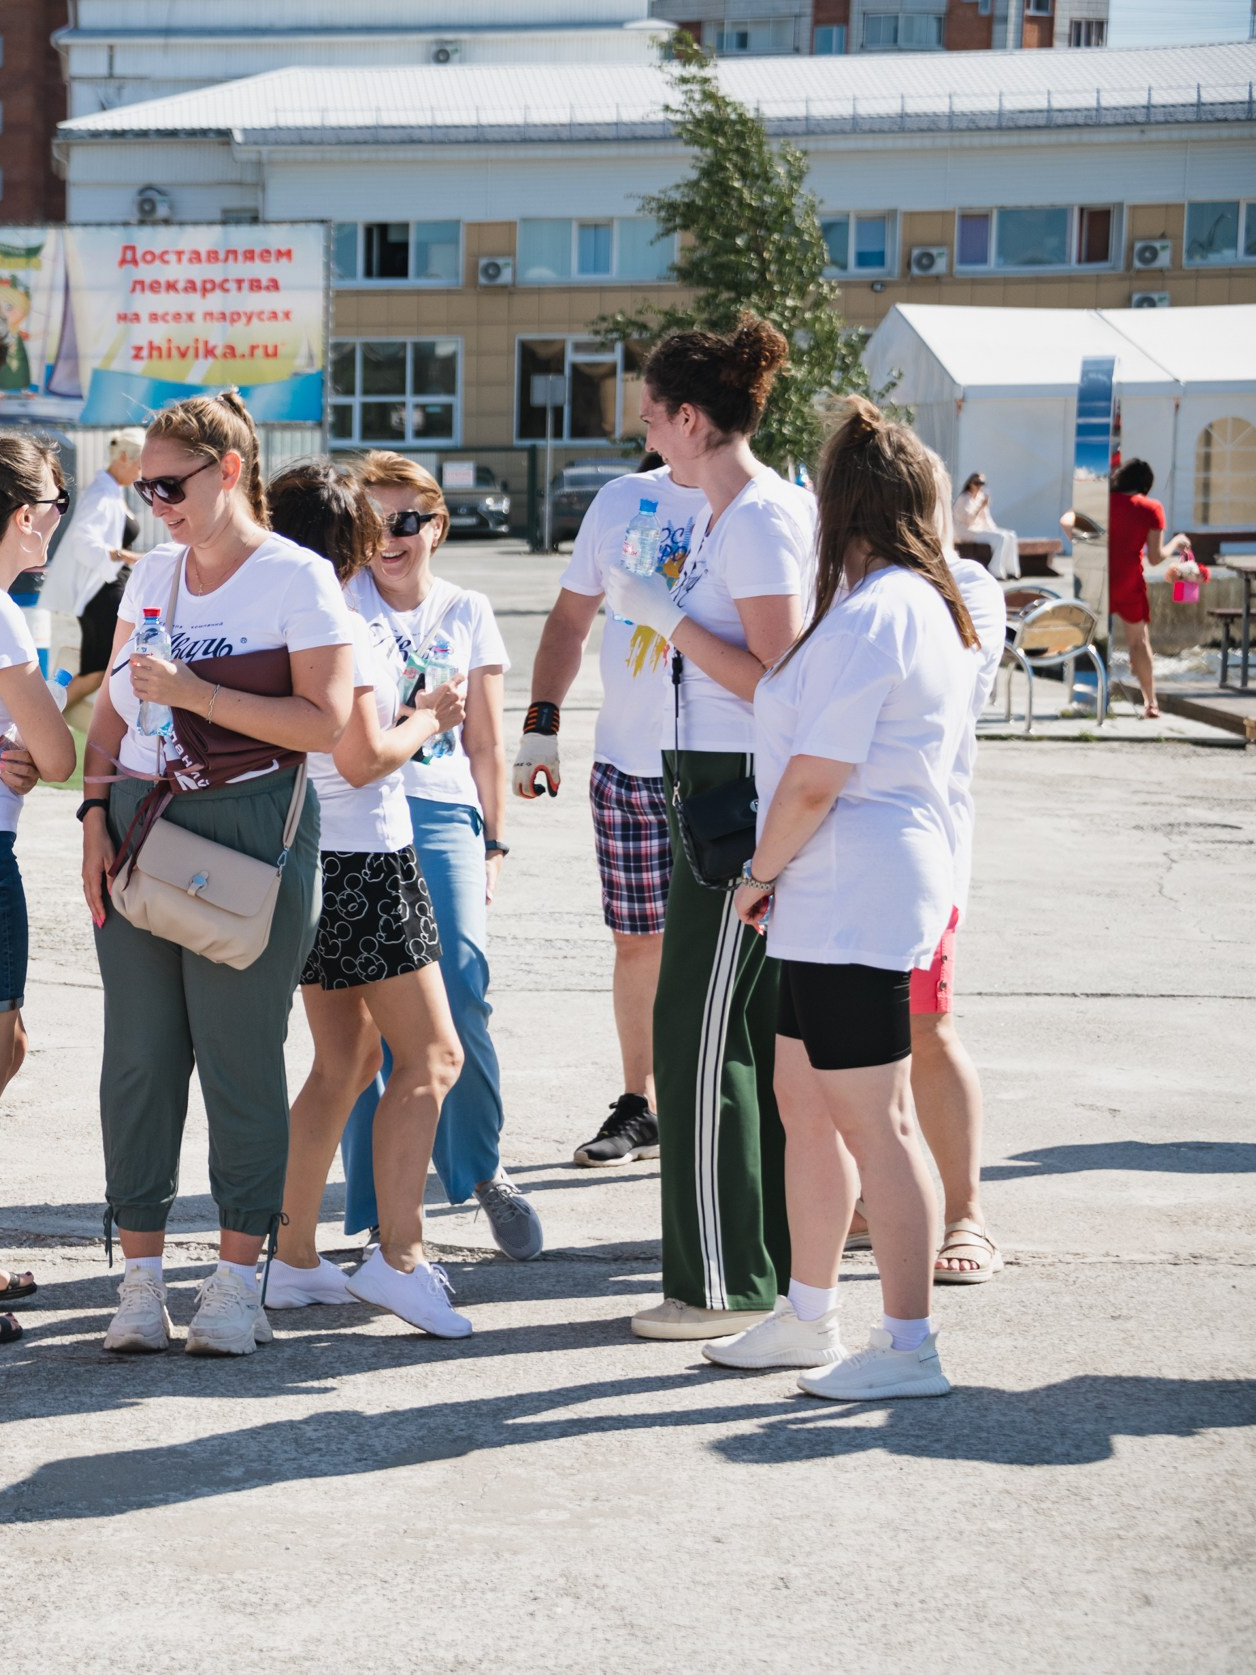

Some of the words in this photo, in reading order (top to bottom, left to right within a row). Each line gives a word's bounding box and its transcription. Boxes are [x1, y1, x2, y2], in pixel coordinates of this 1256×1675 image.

[118, 245, 293, 269] Доставляем
[130, 277, 281, 299] лекарства
[117, 310, 141, 324] на
[148, 310, 195, 324] всех
[203, 309, 292, 327] парусах
[130, 337, 280, 362] zhivika.ru
